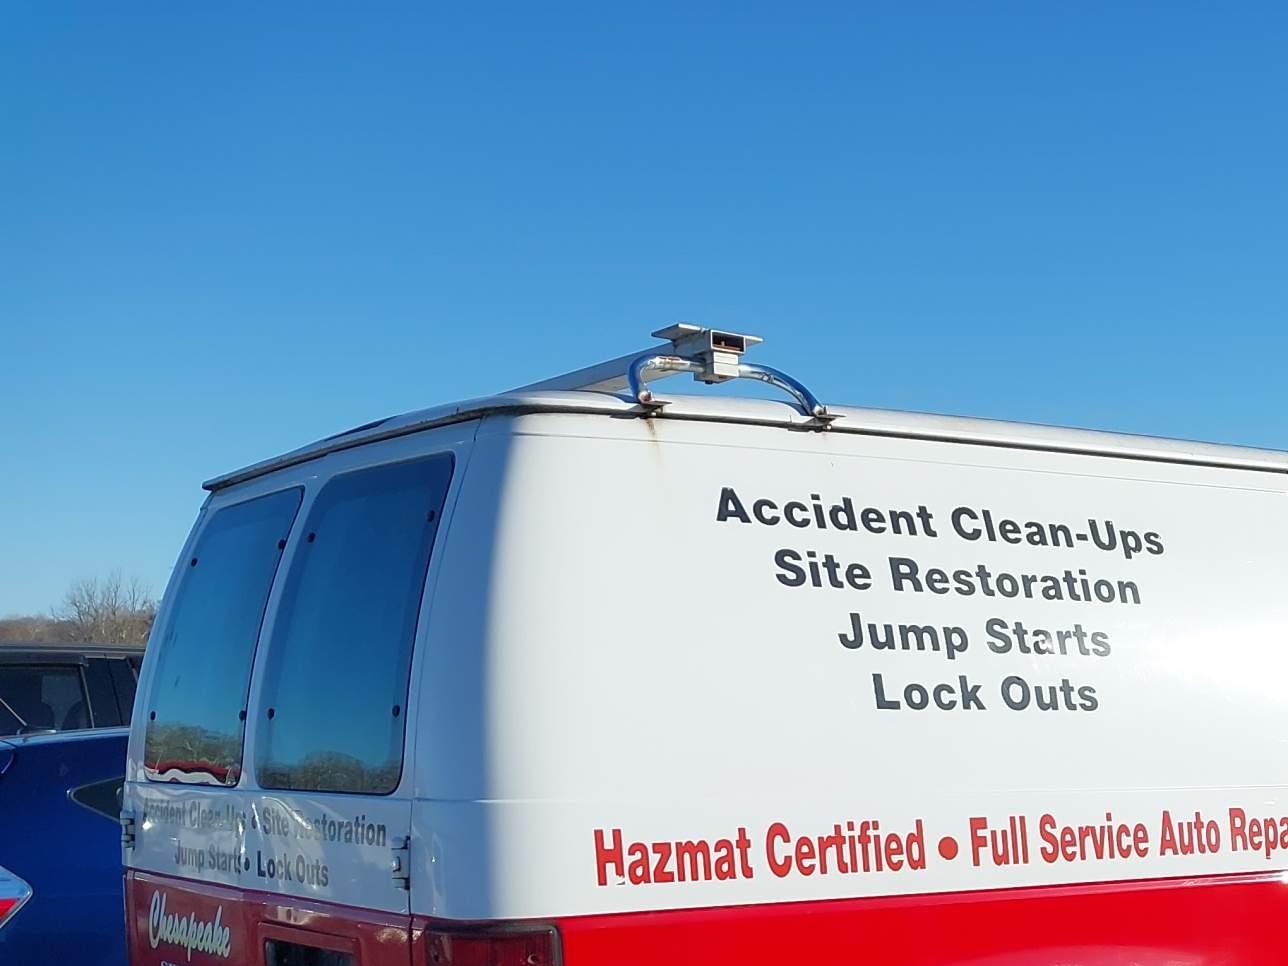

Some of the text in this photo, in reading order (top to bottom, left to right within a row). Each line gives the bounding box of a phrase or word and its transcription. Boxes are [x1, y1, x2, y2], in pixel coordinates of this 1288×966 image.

[715, 486, 1164, 560] Accident Clean-Ups
[773, 548, 1141, 604] Site Restoration
[838, 612, 1111, 660] Jump Starts
[872, 673, 1099, 711] Lock Outs
[262, 806, 289, 836] Site
[175, 839, 204, 873] Jump
[257, 850, 291, 881] Lock
[296, 854, 328, 887] Outs
[593, 826, 754, 887] Hazmat
[766, 818, 926, 877] Certified
[969, 814, 1029, 867] Full
[1040, 809, 1149, 864] Service
[1159, 808, 1222, 856] Auto
[149, 889, 231, 962] Chesapeake
